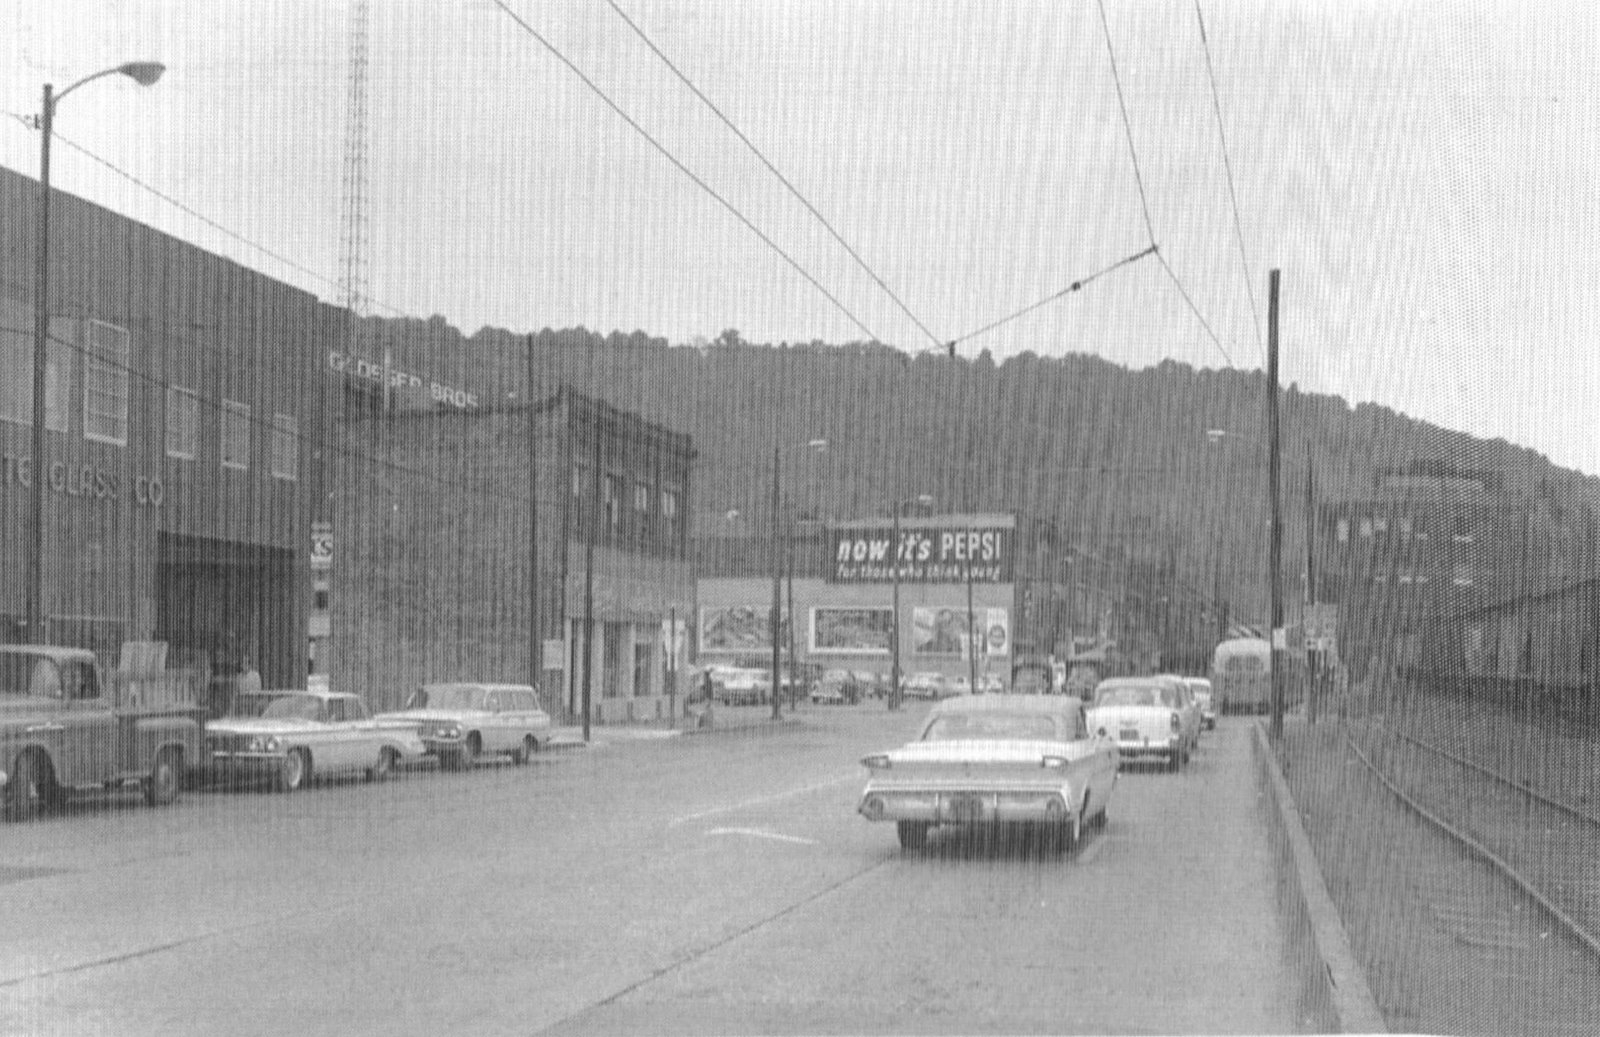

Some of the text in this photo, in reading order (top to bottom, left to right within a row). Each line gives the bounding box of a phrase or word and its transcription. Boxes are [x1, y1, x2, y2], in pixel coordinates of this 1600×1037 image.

[431, 382, 479, 408] BROS
[51, 461, 118, 499] GLASS
[136, 475, 163, 506] CO
[837, 532, 1001, 562] now it's PEPSI
[838, 564, 857, 579] for
[861, 565, 895, 579] those
[898, 564, 924, 579] who
[927, 564, 959, 579] think
